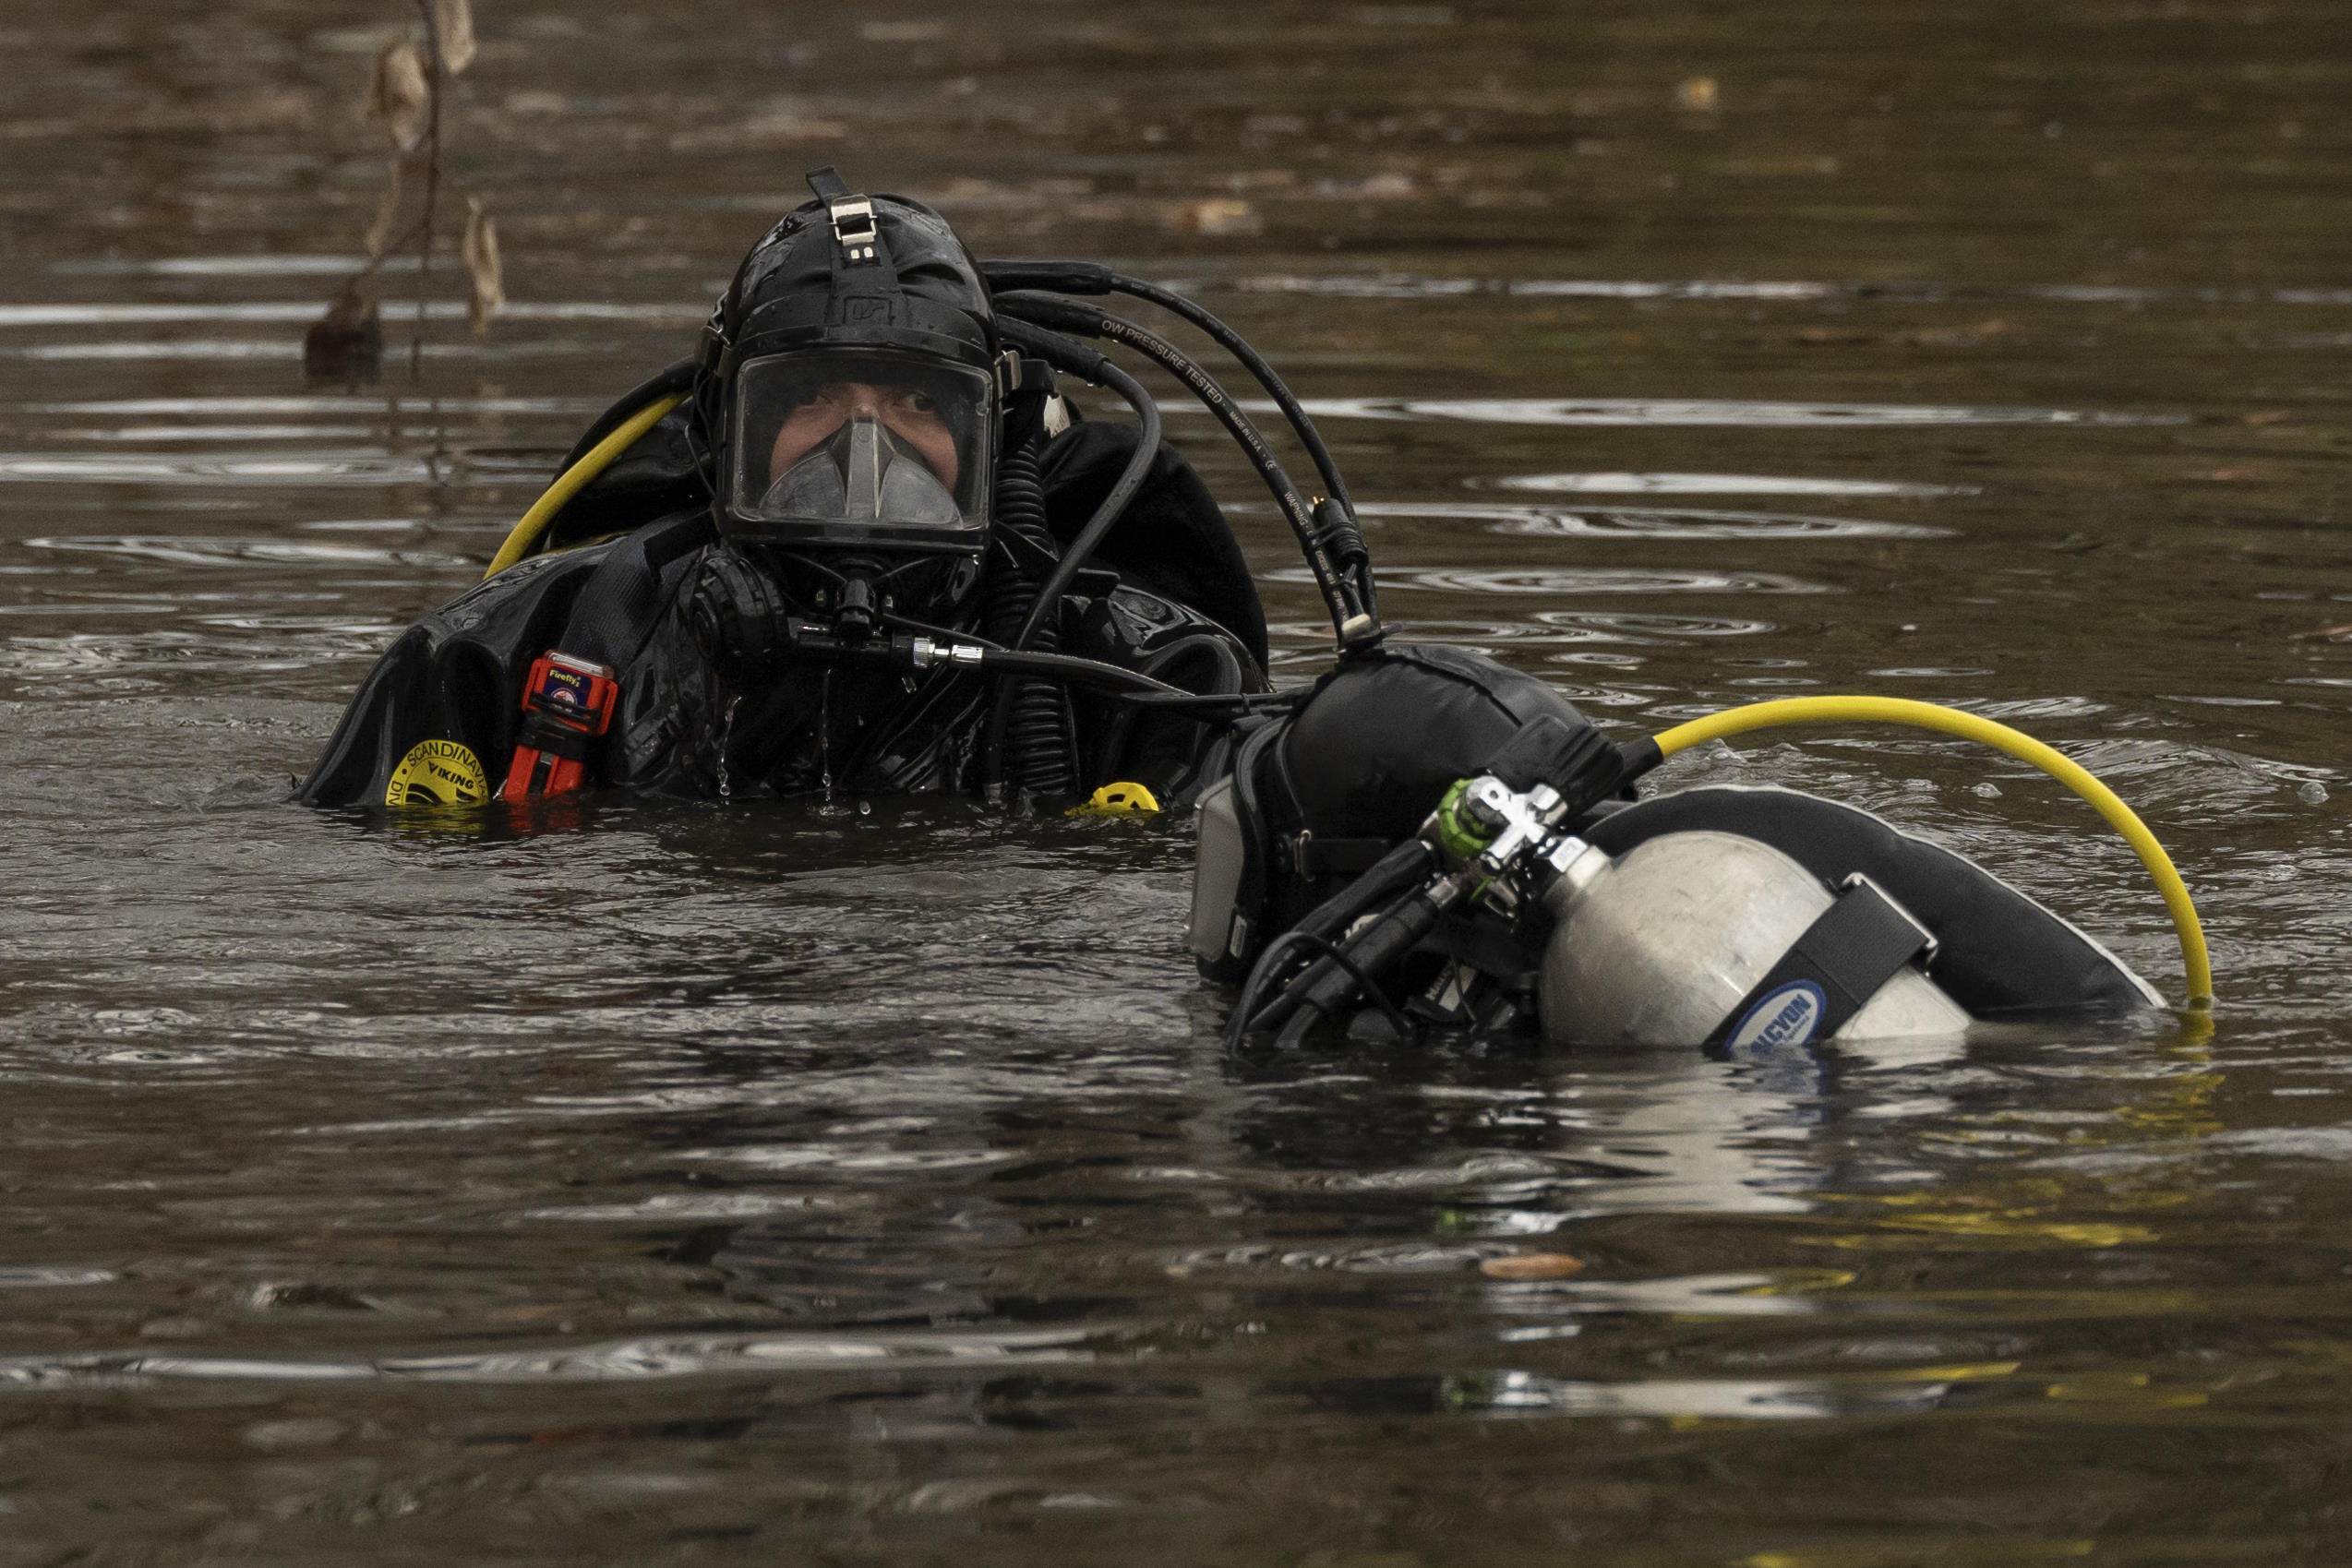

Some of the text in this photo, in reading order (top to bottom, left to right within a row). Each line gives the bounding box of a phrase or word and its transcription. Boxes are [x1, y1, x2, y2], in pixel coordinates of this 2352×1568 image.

[1101, 319, 1125, 334] OW
[1126, 328, 1186, 370] PRESSURE
[1185, 365, 1223, 404] TESTED
[1229, 411, 1246, 430] MADE
[1242, 427, 1251, 437] IN
[1284, 490, 1309, 527] WARNING
[427, 760, 474, 790] VIKING
[389, 780, 404, 807] DIV
[1750, 993, 1812, 1054] LCYON
